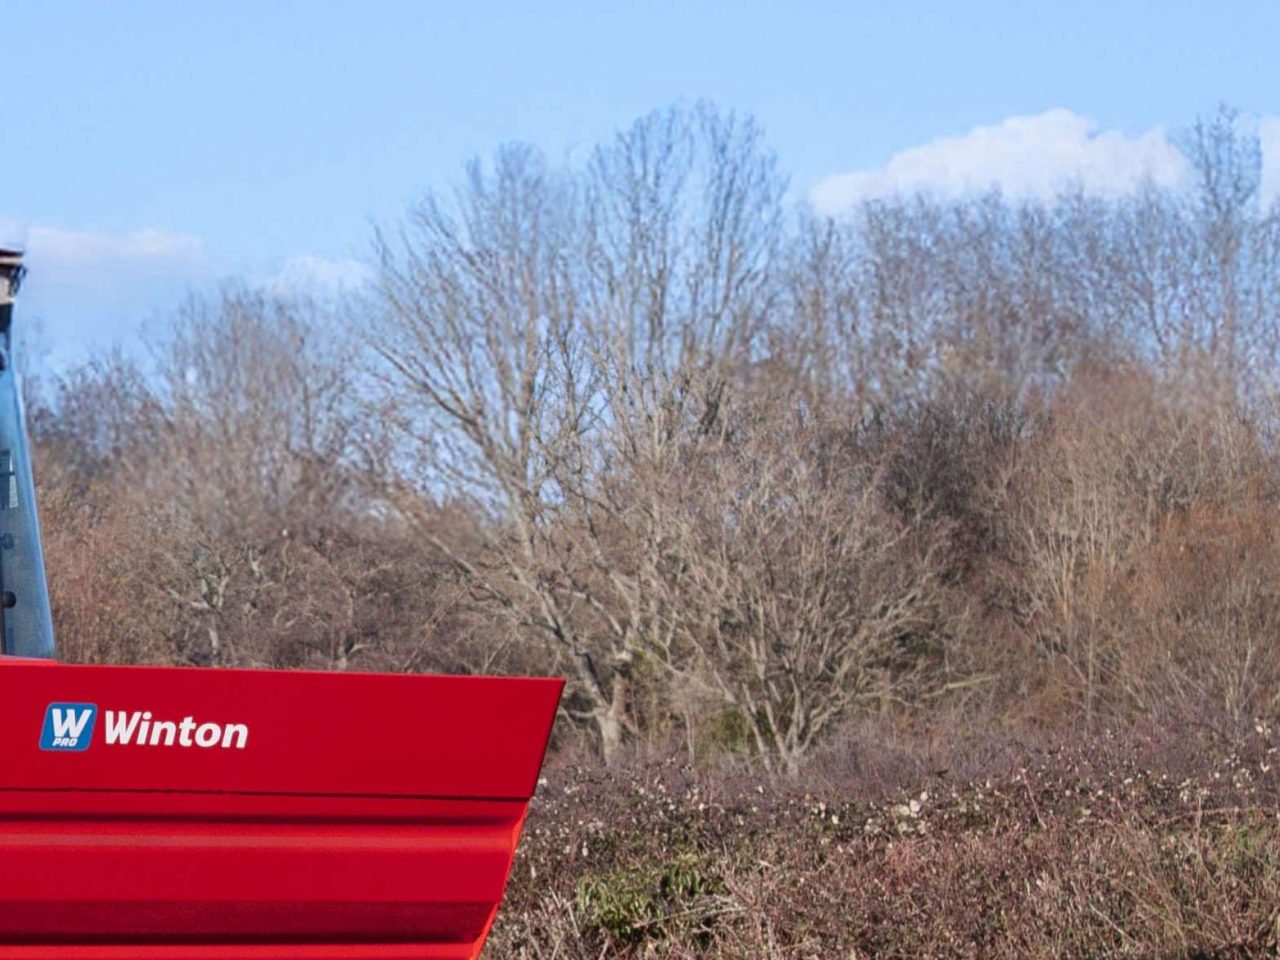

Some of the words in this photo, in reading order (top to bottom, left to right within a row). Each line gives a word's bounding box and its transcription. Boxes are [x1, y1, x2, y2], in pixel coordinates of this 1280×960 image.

[52, 708, 93, 738] W
[105, 710, 248, 748] Winton
[52, 737, 79, 747] PRO
